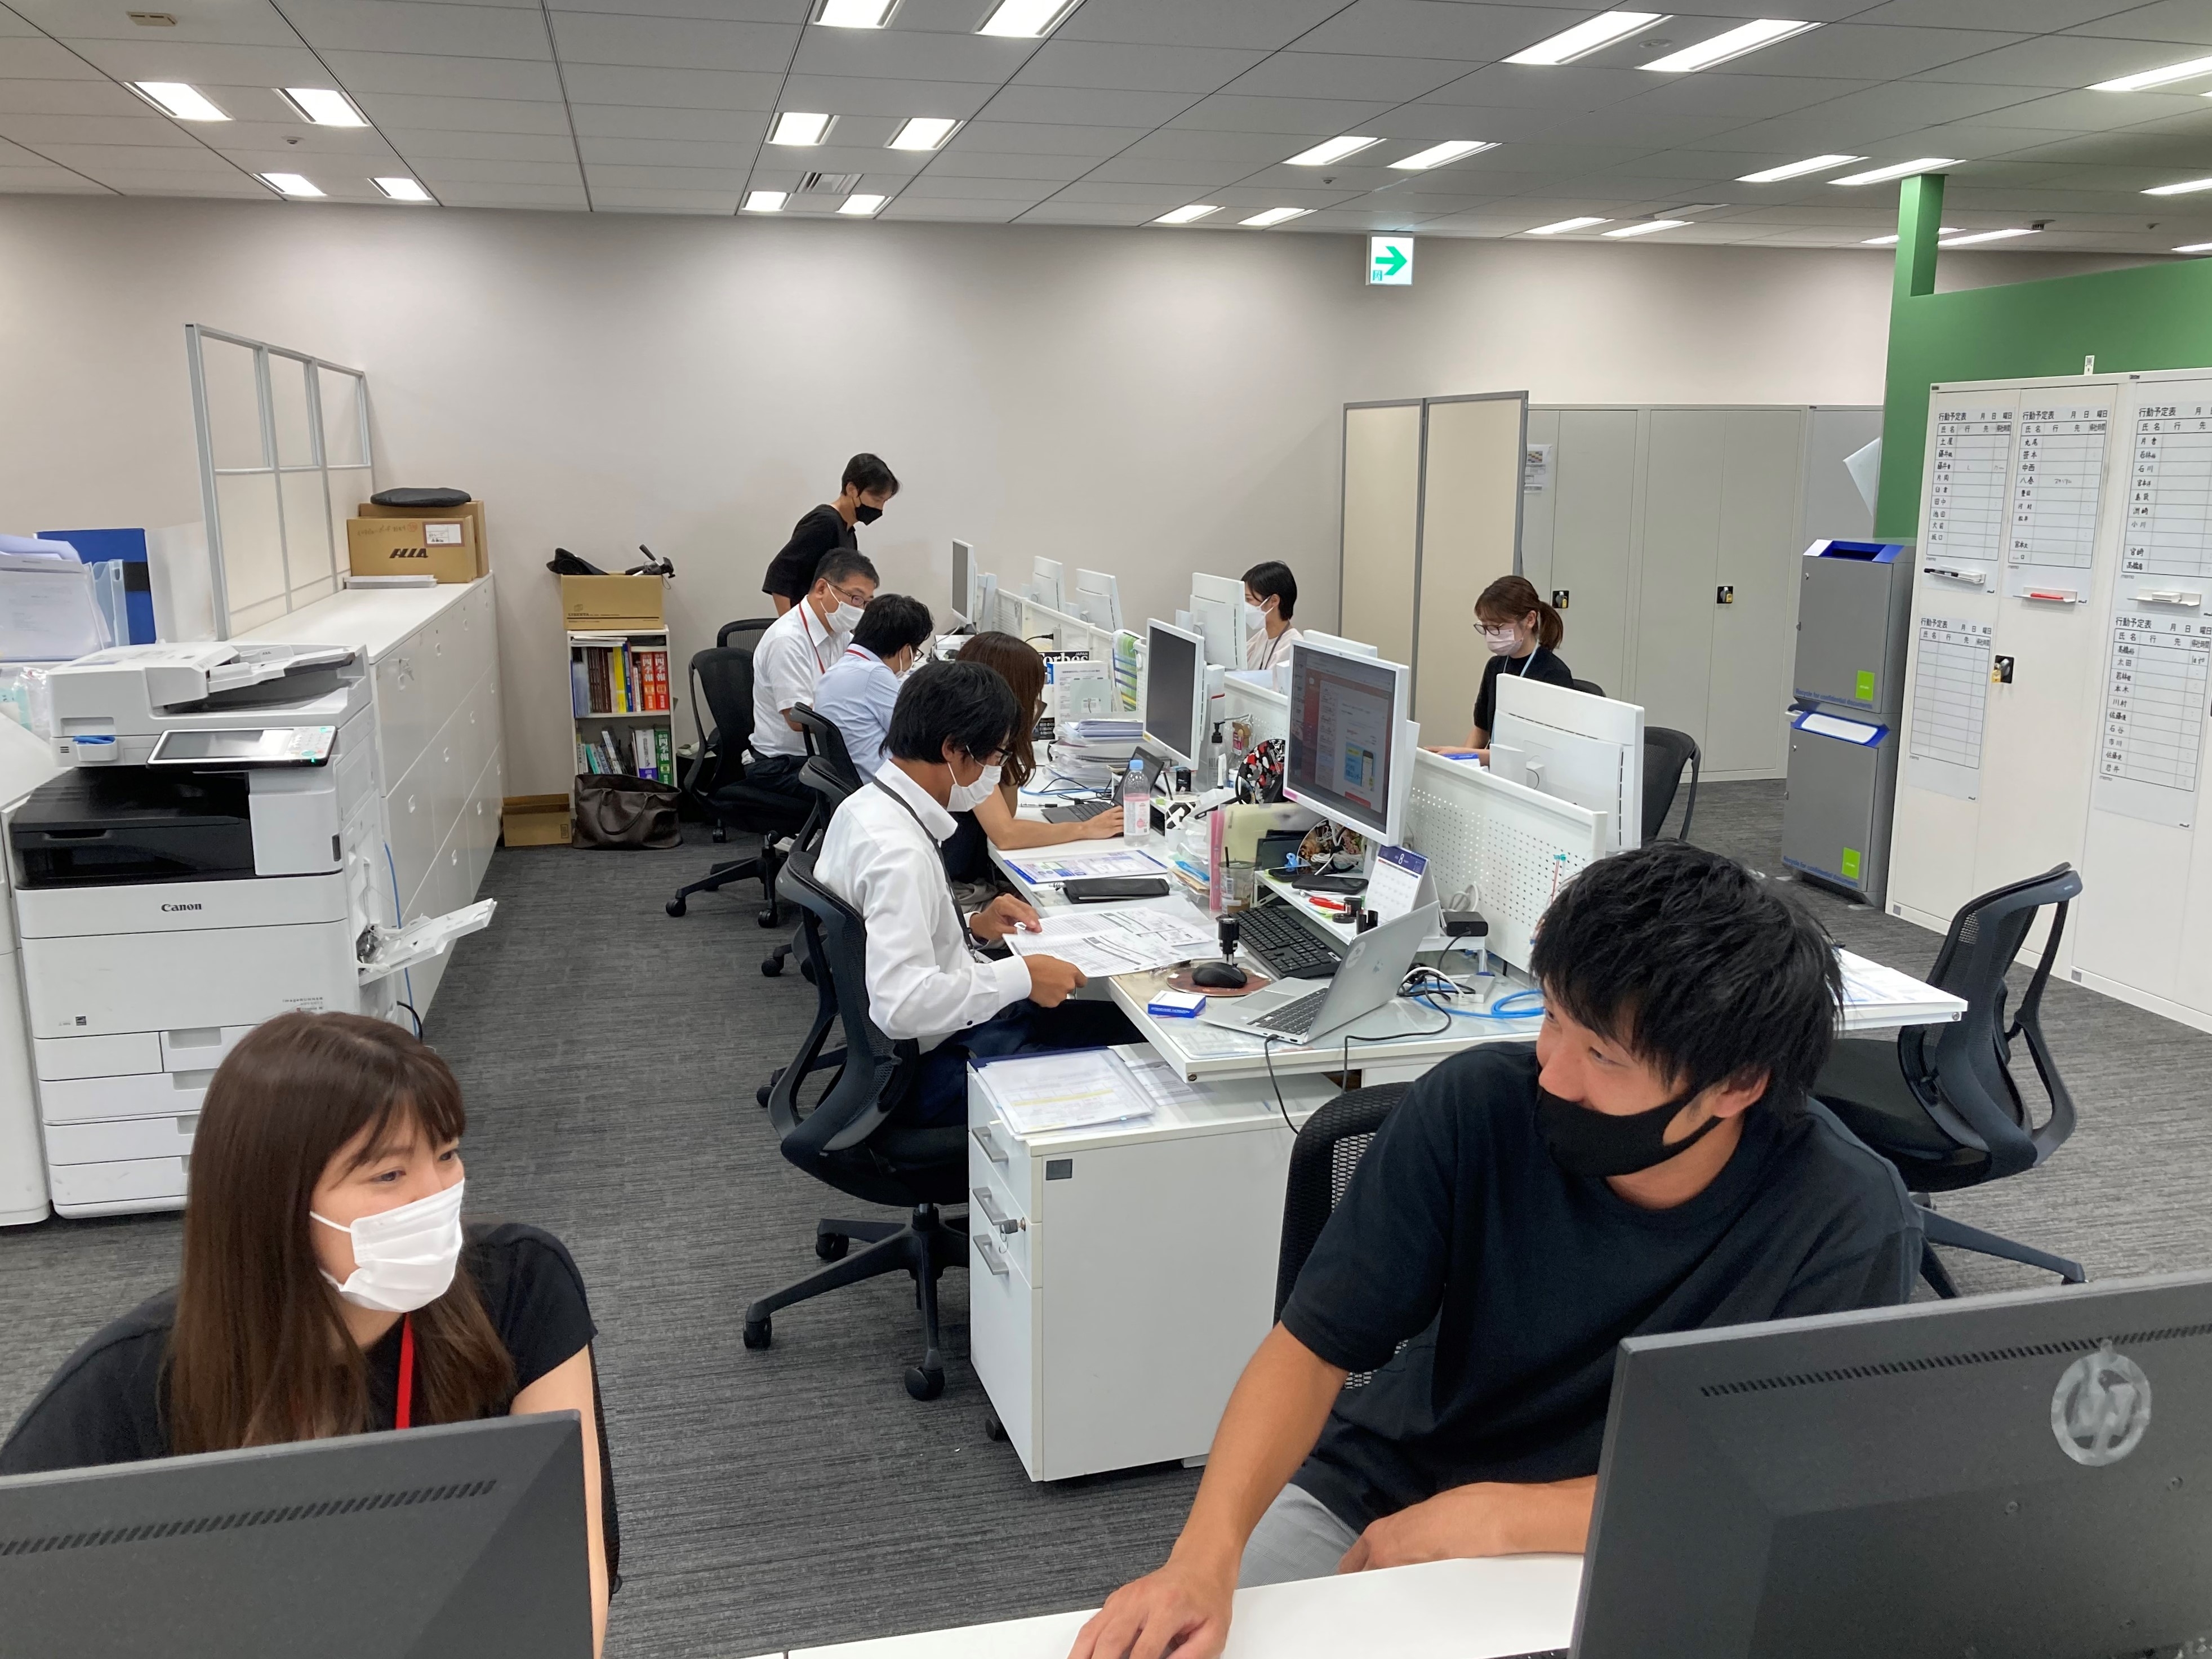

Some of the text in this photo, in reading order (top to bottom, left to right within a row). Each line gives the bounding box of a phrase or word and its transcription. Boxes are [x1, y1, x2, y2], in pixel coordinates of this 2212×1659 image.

[1939, 412, 1966, 421] 行動予定表
[2023, 411, 2054, 420] 行動予定表
[2139, 407, 2176, 417] 行動予定表
[2195, 407, 2201, 415] 月
[1921, 617, 1948, 629] 行動予定表
[2116, 617, 2151, 629] 行動予定表
[2170, 623, 2176, 631] 月
[2200, 626, 2211, 635] 曜日
[2113, 699, 2127, 708] 川村
[1398, 853, 1404, 864] 8
